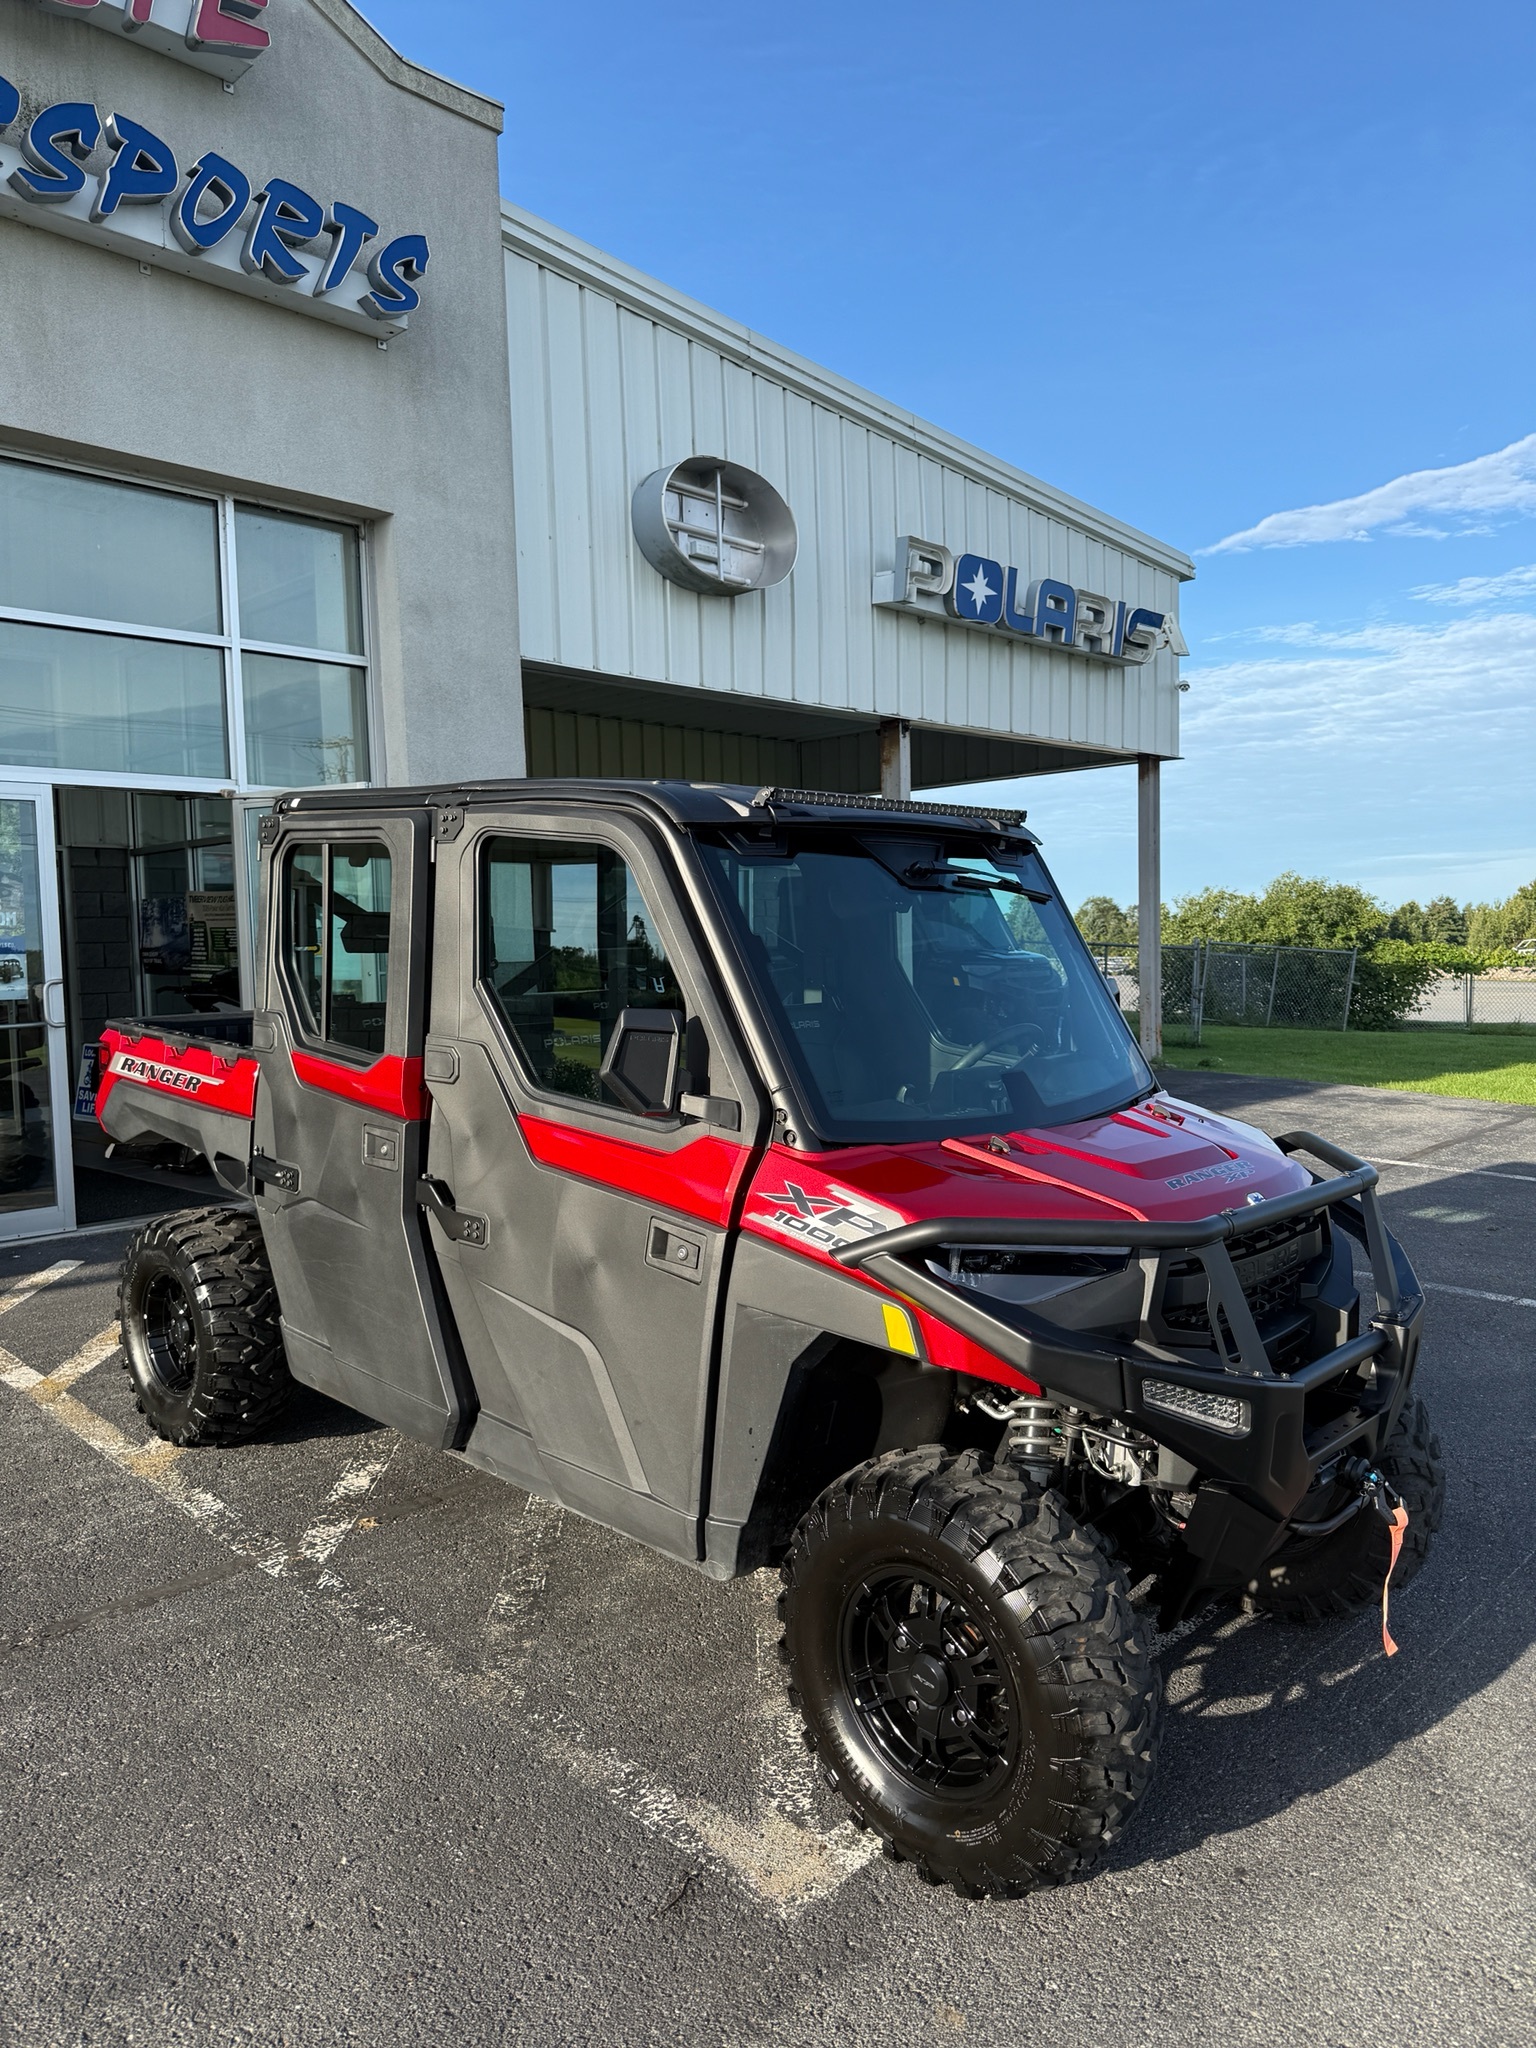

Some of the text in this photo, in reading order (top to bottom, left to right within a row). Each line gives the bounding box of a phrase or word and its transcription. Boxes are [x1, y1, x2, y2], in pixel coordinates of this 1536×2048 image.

[0, 75, 430, 320] SPORTS
[893, 535, 1165, 664] POLARIS
[790, 1020, 820, 1030] LARIS
[543, 1034, 601, 1049] POLARIS
[119, 1056, 202, 1092] RANGER
[78, 1089, 97, 1101] SAV
[82, 1102, 96, 1114] LIF
[1165, 1159, 1254, 1190] RANGER
[1222, 1169, 1255, 1184] XP
[755, 1180, 887, 1236] XP
